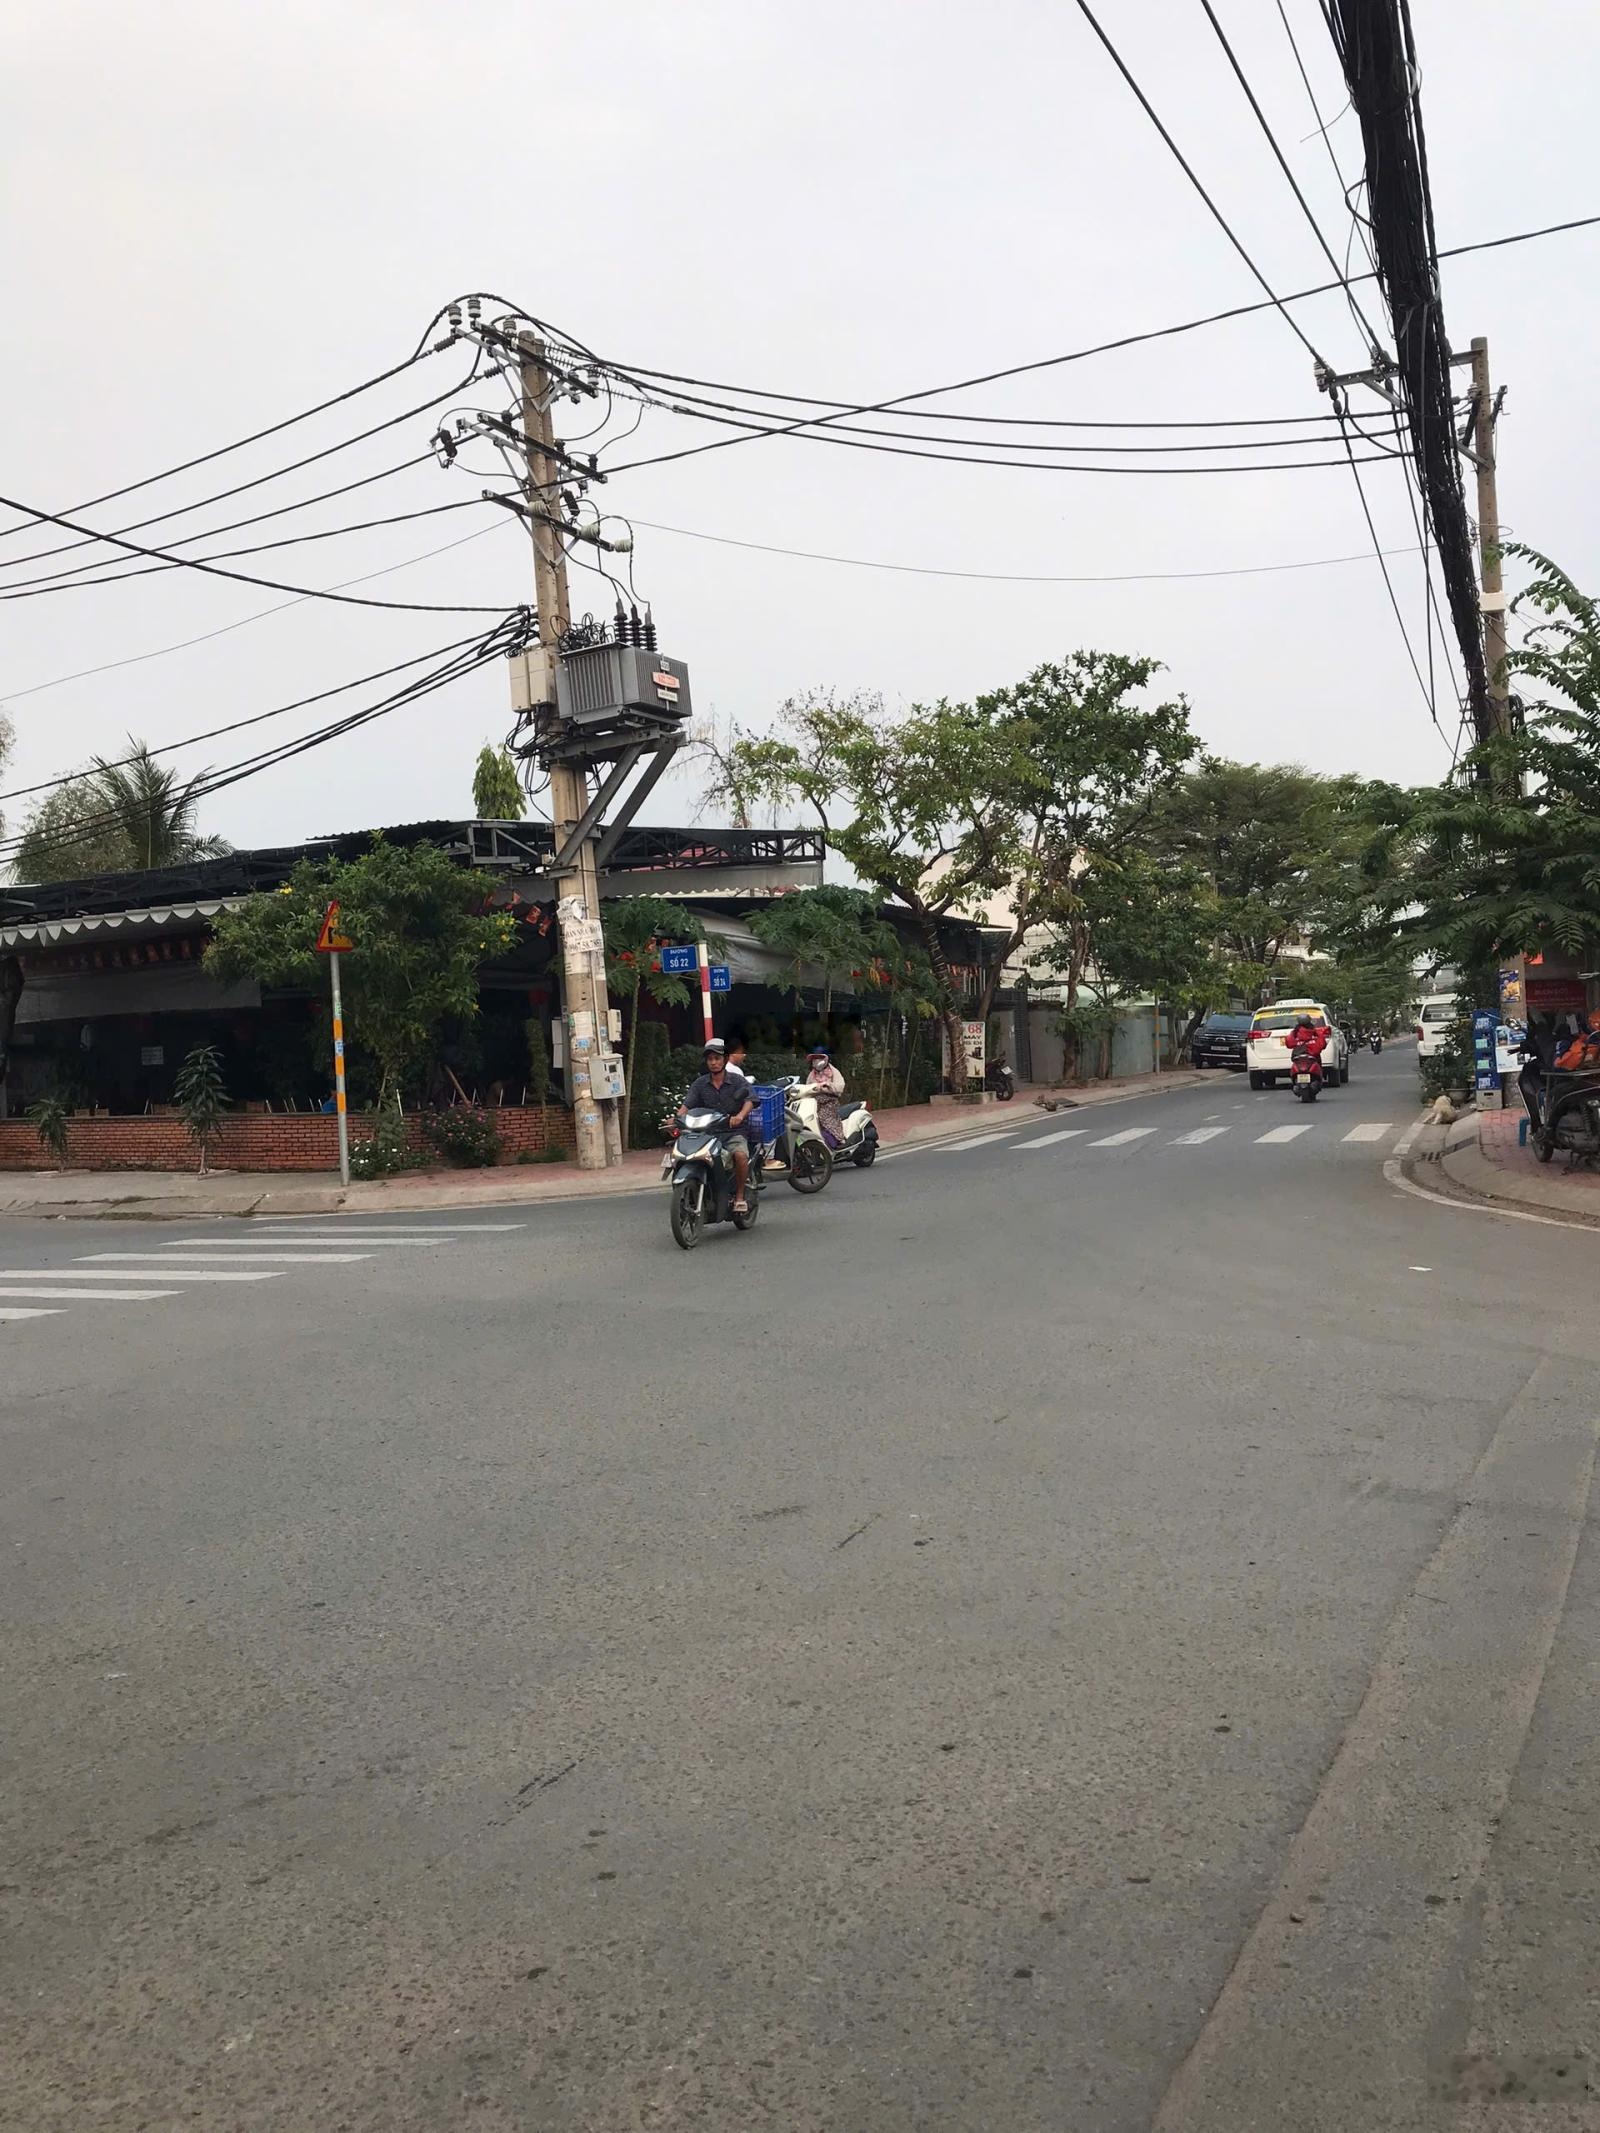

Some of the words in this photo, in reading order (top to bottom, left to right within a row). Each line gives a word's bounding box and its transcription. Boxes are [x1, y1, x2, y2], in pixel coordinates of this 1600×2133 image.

[670, 956, 679, 968] SỐ
[680, 958, 688, 967] 22
[968, 1024, 982, 1034] 68
